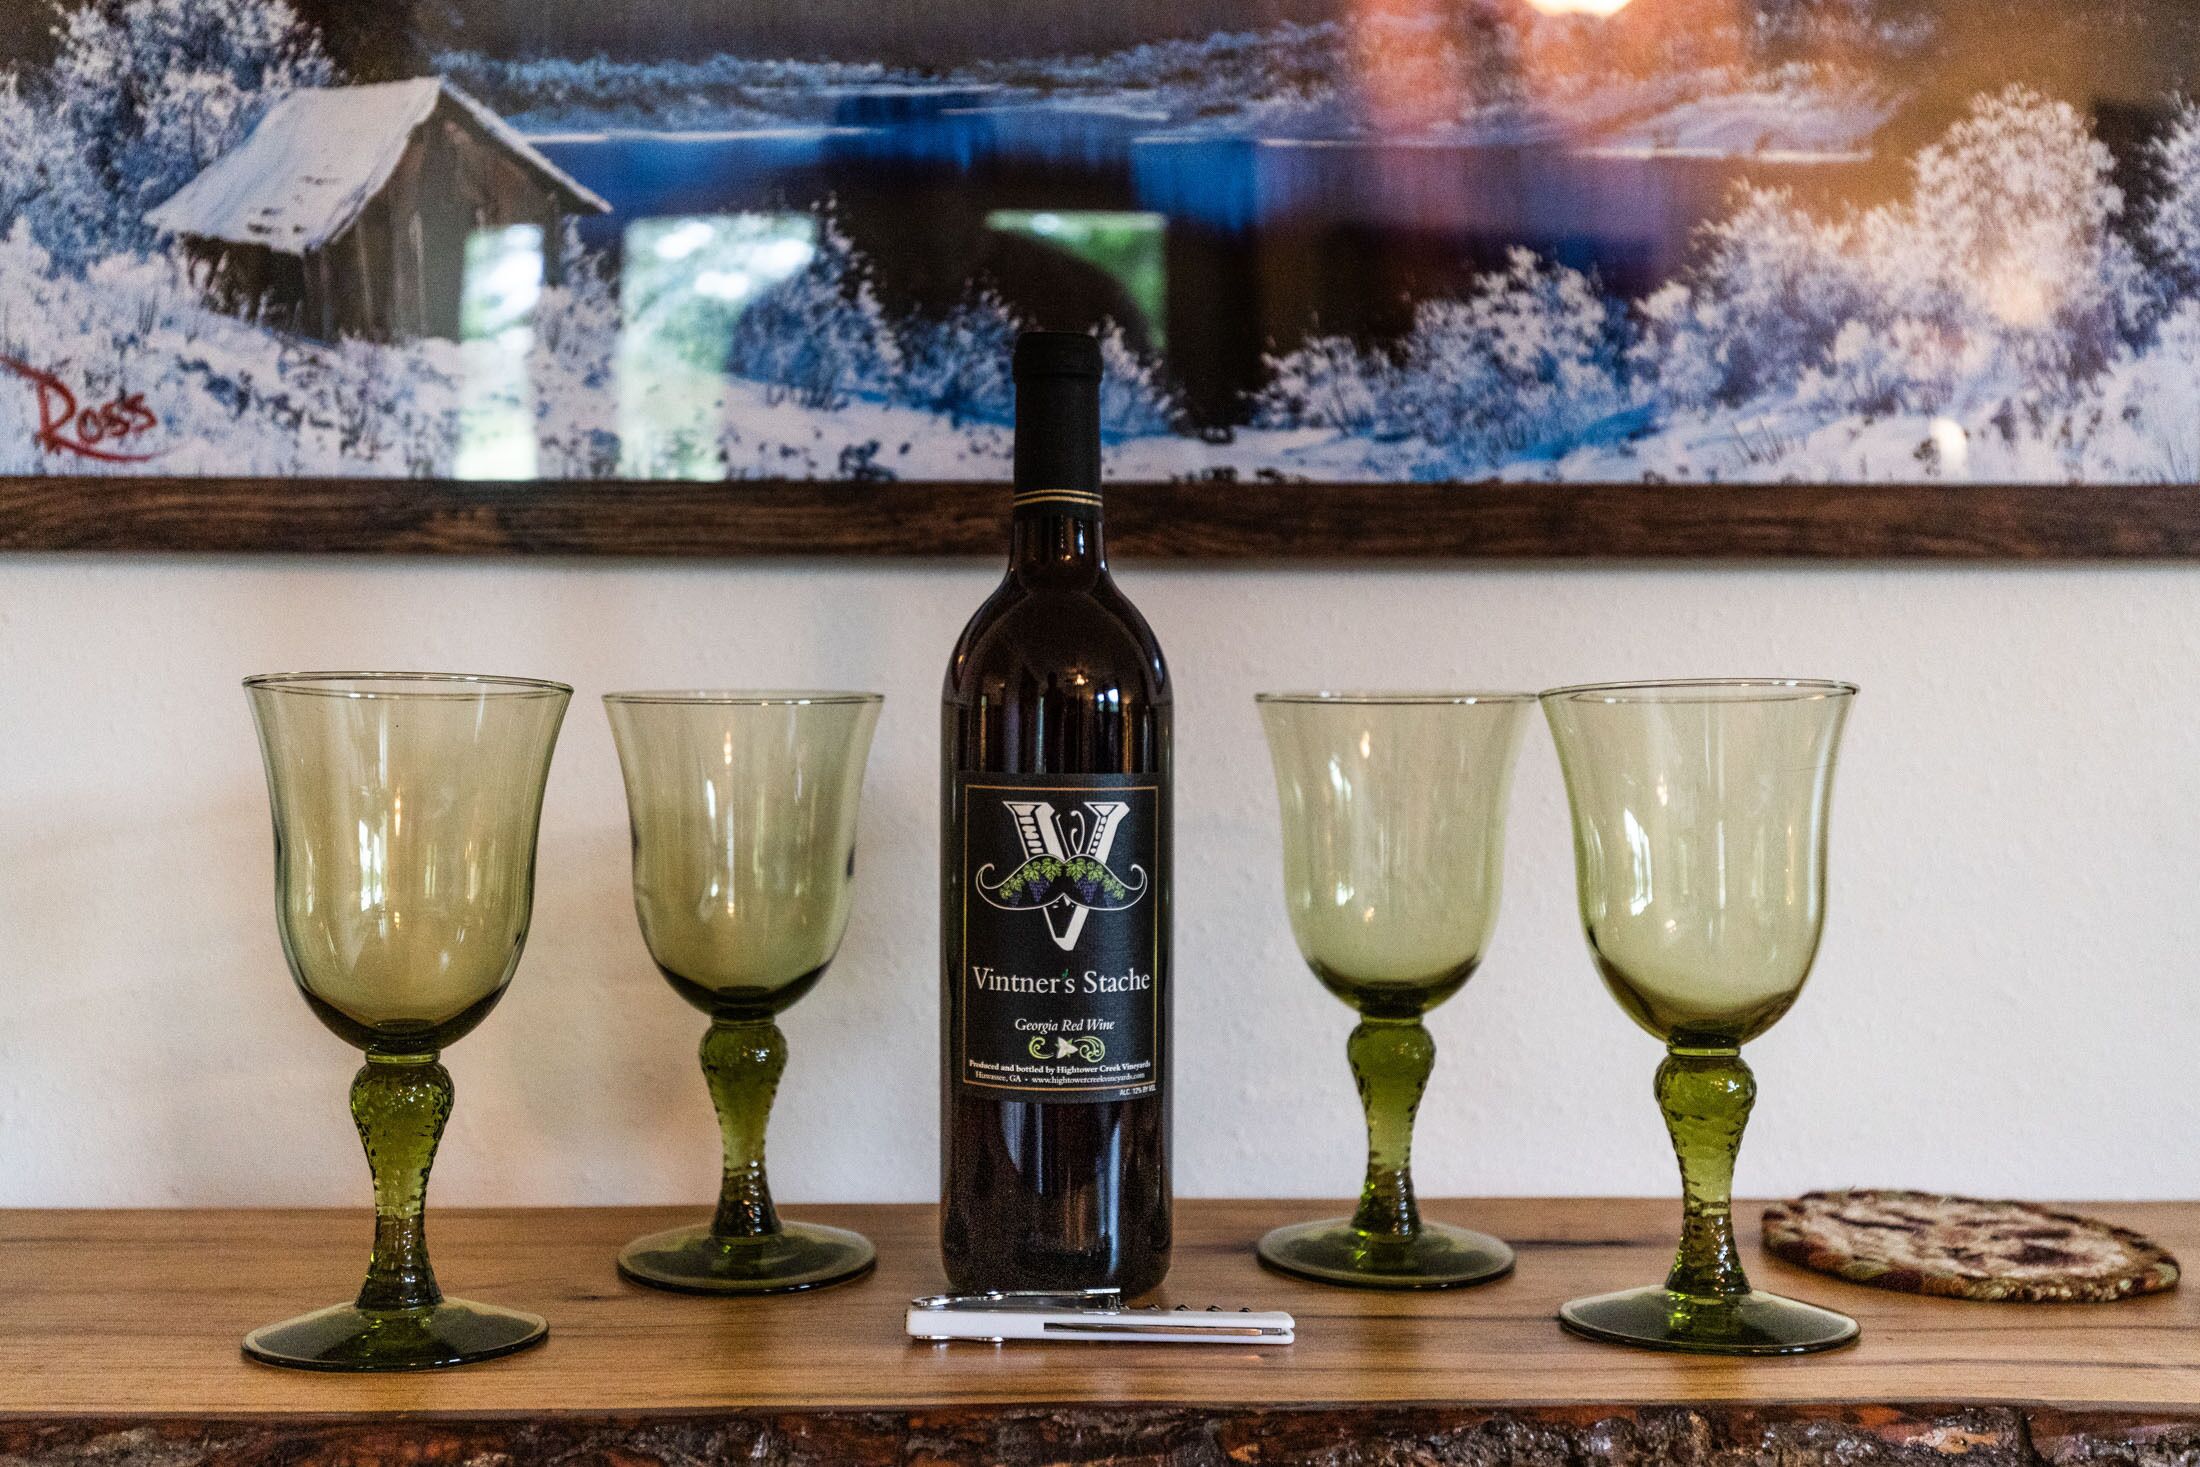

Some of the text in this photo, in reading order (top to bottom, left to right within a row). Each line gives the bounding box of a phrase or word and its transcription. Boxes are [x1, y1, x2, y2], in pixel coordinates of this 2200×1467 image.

[2, 356, 160, 463] Ross
[972, 966, 1151, 994] Vintner's Stache
[1014, 1018, 1116, 1035] Georgia Red Wine
[969, 1059, 1151, 1075] Produced and bottled by Hightower Creek Vineyards
[1009, 1074, 1022, 1083] GA
